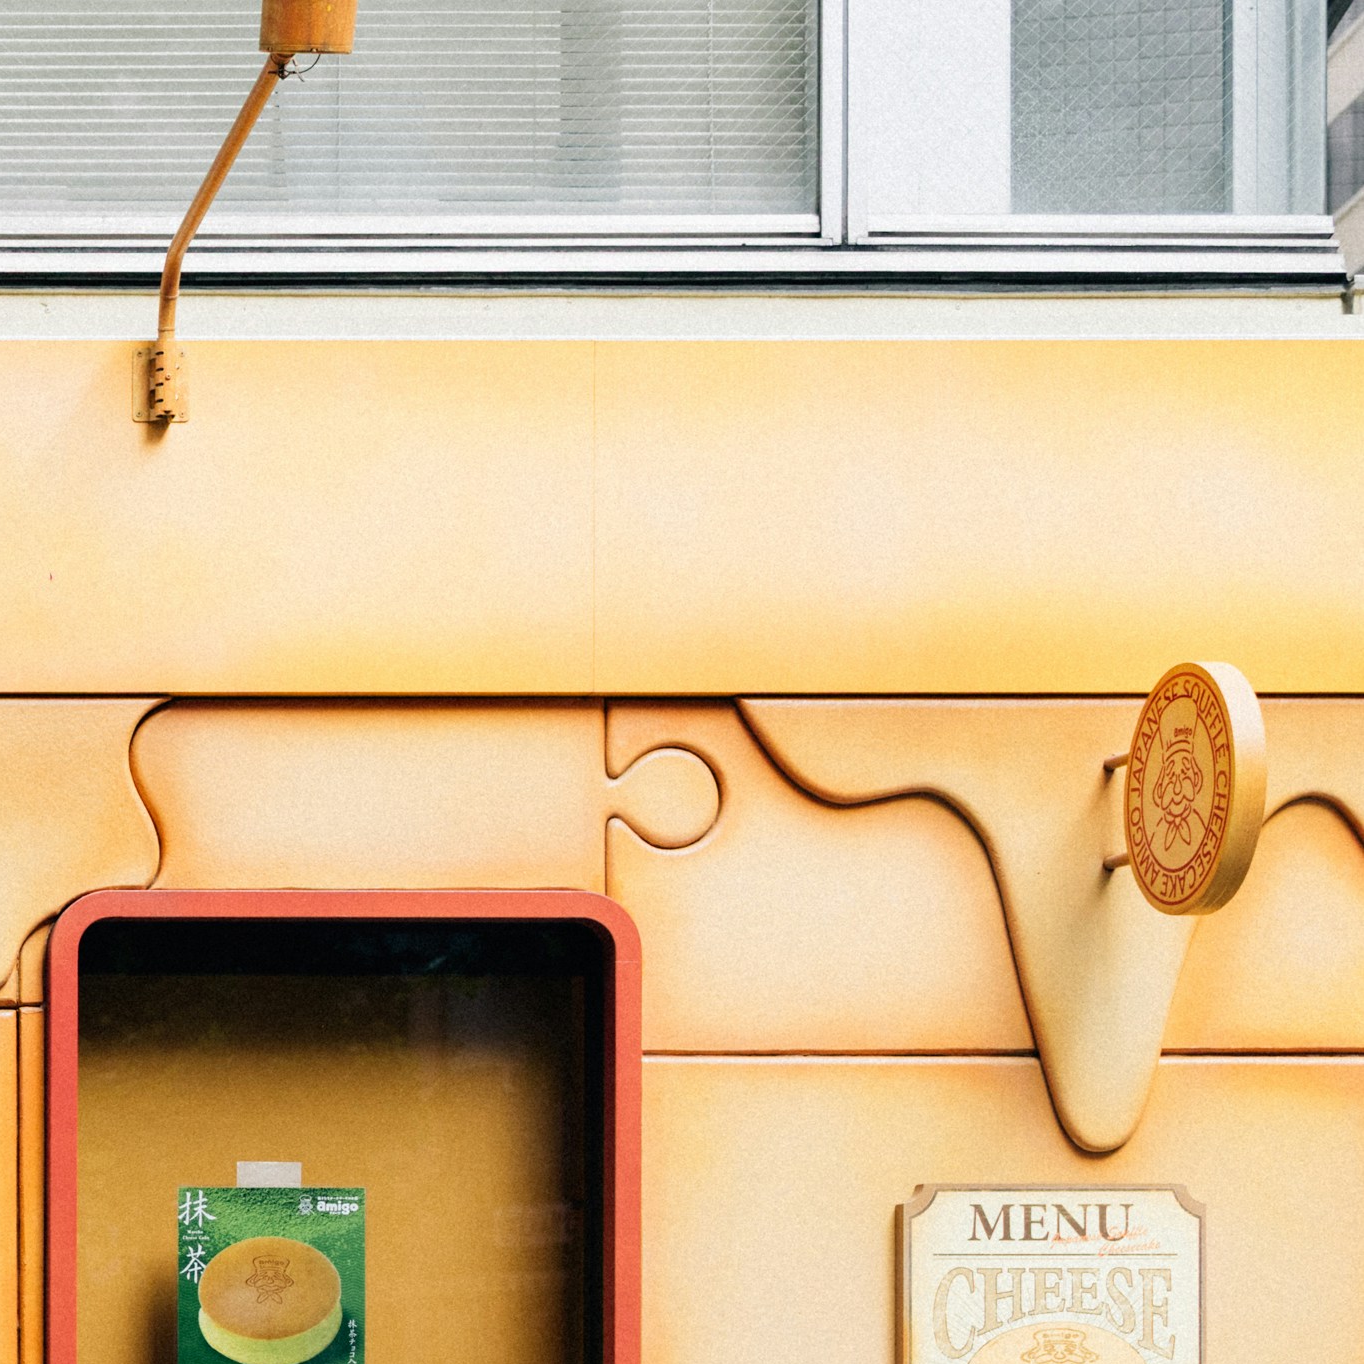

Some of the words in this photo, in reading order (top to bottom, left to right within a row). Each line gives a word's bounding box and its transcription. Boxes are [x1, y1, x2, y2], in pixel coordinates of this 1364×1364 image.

[1130, 681, 1180, 798] JAPANESE
[1173, 725, 1193, 738] amigo
[1131, 806, 1159, 887] AMIGO
[1160, 770, 1229, 899] CHEESECAKE
[316, 1200, 359, 1215] amigo
[967, 1203, 1134, 1241] MENU
[932, 1266, 1176, 1361] CHEESE
